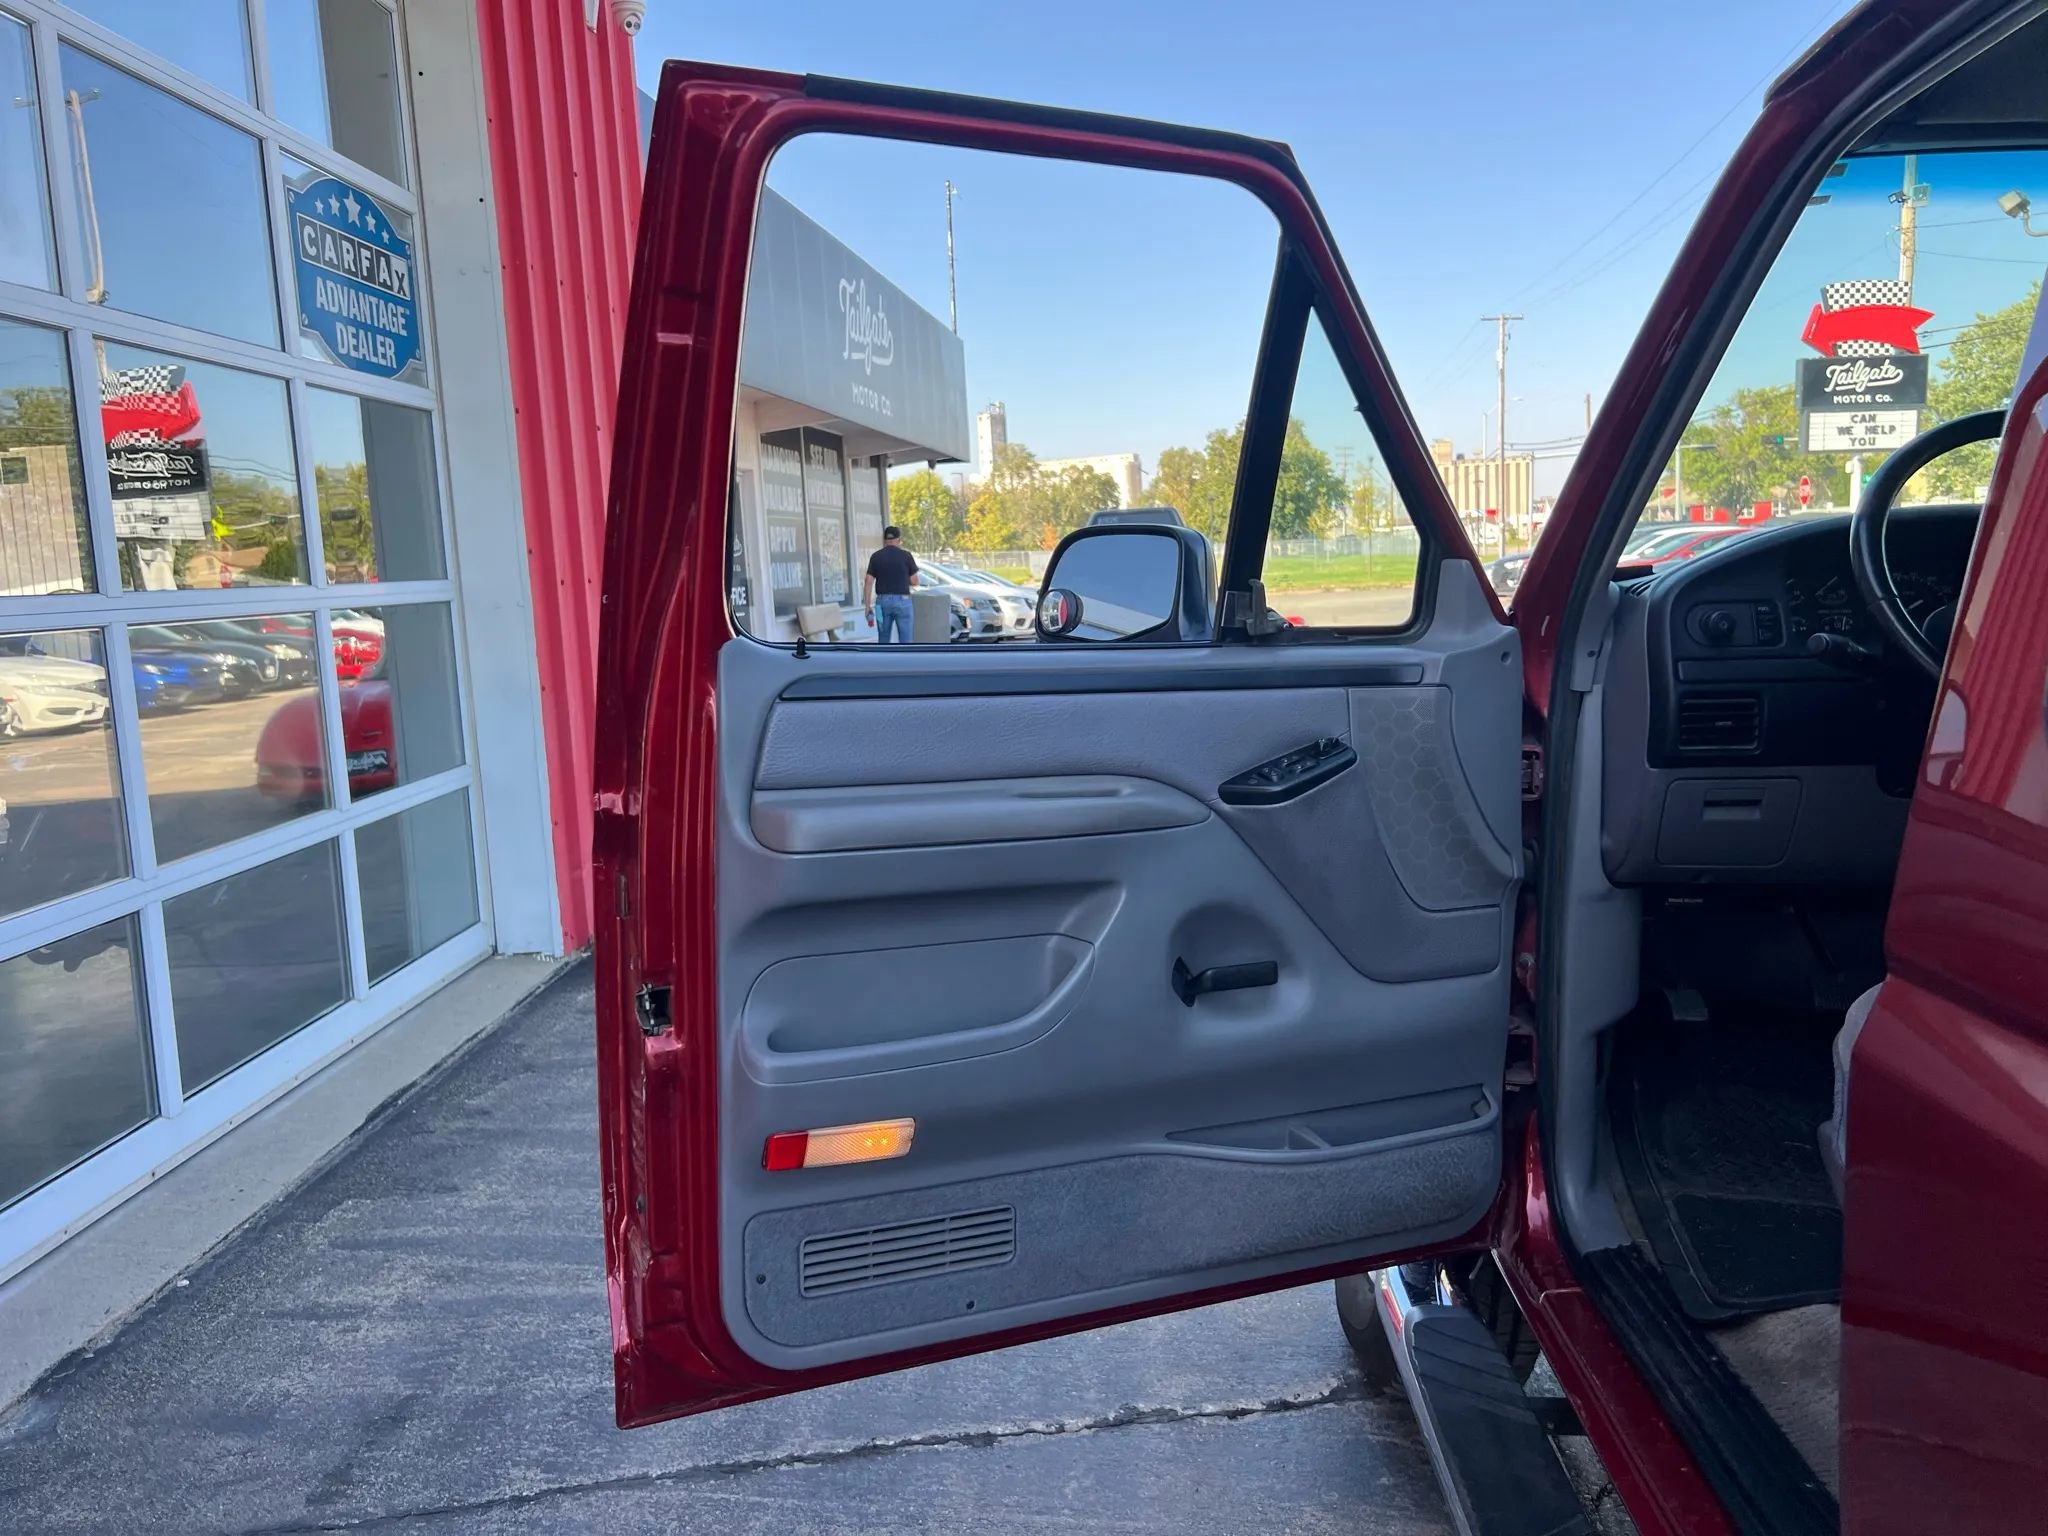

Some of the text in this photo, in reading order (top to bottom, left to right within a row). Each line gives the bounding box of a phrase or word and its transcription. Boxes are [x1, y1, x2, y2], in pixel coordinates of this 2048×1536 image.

[302, 225, 408, 298] CARFAX
[316, 276, 408, 337] ADVANTAGE
[838, 277, 894, 376] Tailgate
[336, 321, 397, 369] DEALER
[1824, 358, 1904, 393] Tailgate
[852, 382, 879, 413] MOTOR
[1833, 394, 1872, 405] MOTOR
[1836, 424, 1897, 436] WE HELP
[1850, 413, 1877, 424] CAN
[1848, 436, 1876, 447] YOU
